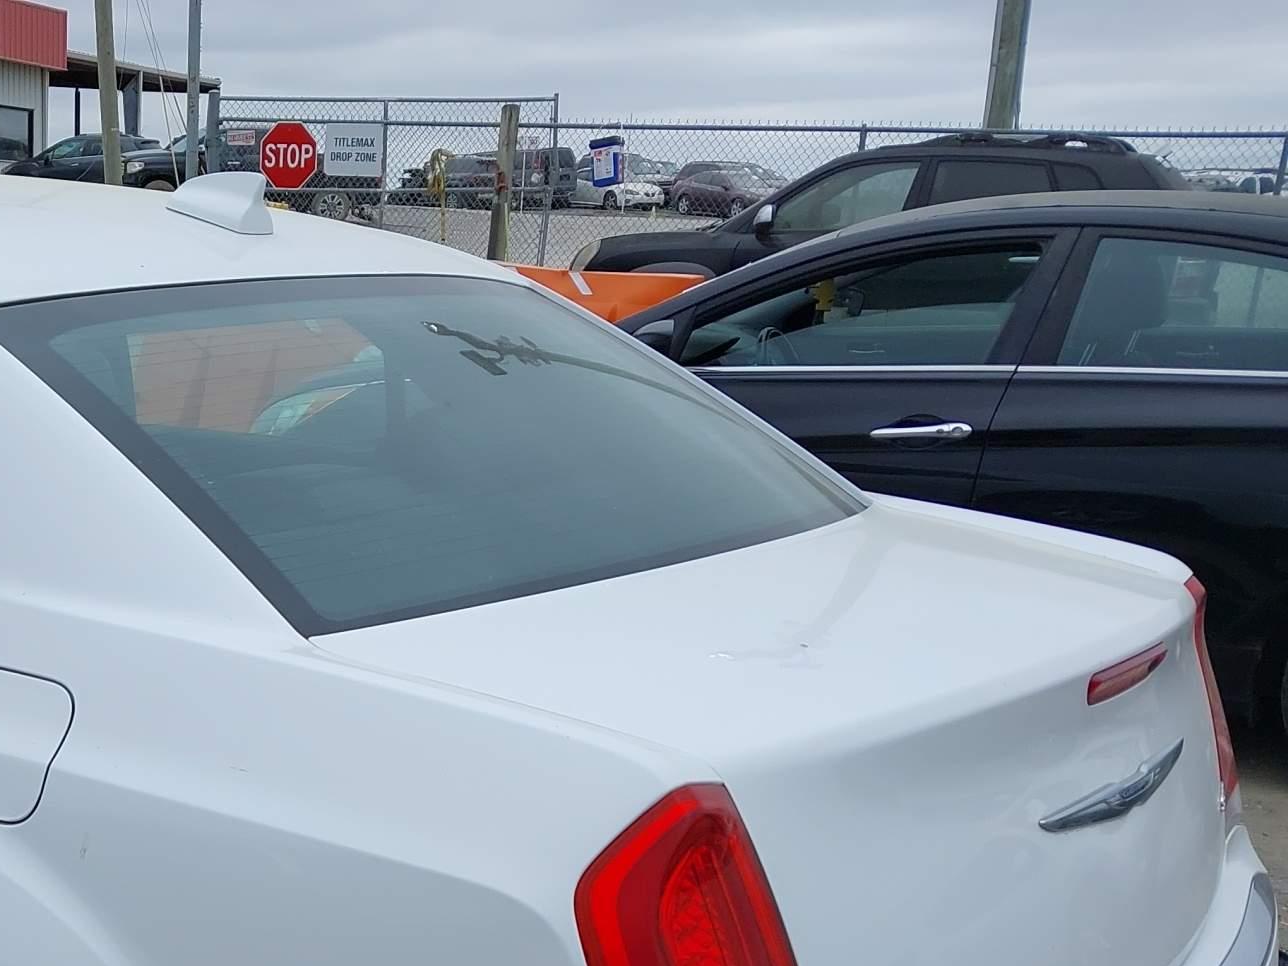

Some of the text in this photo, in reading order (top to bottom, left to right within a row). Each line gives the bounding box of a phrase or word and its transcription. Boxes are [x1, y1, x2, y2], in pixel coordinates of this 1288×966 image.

[334, 137, 376, 148] TITLEMAX
[264, 143, 313, 168] STOP
[330, 151, 377, 162] DROP ZONE
